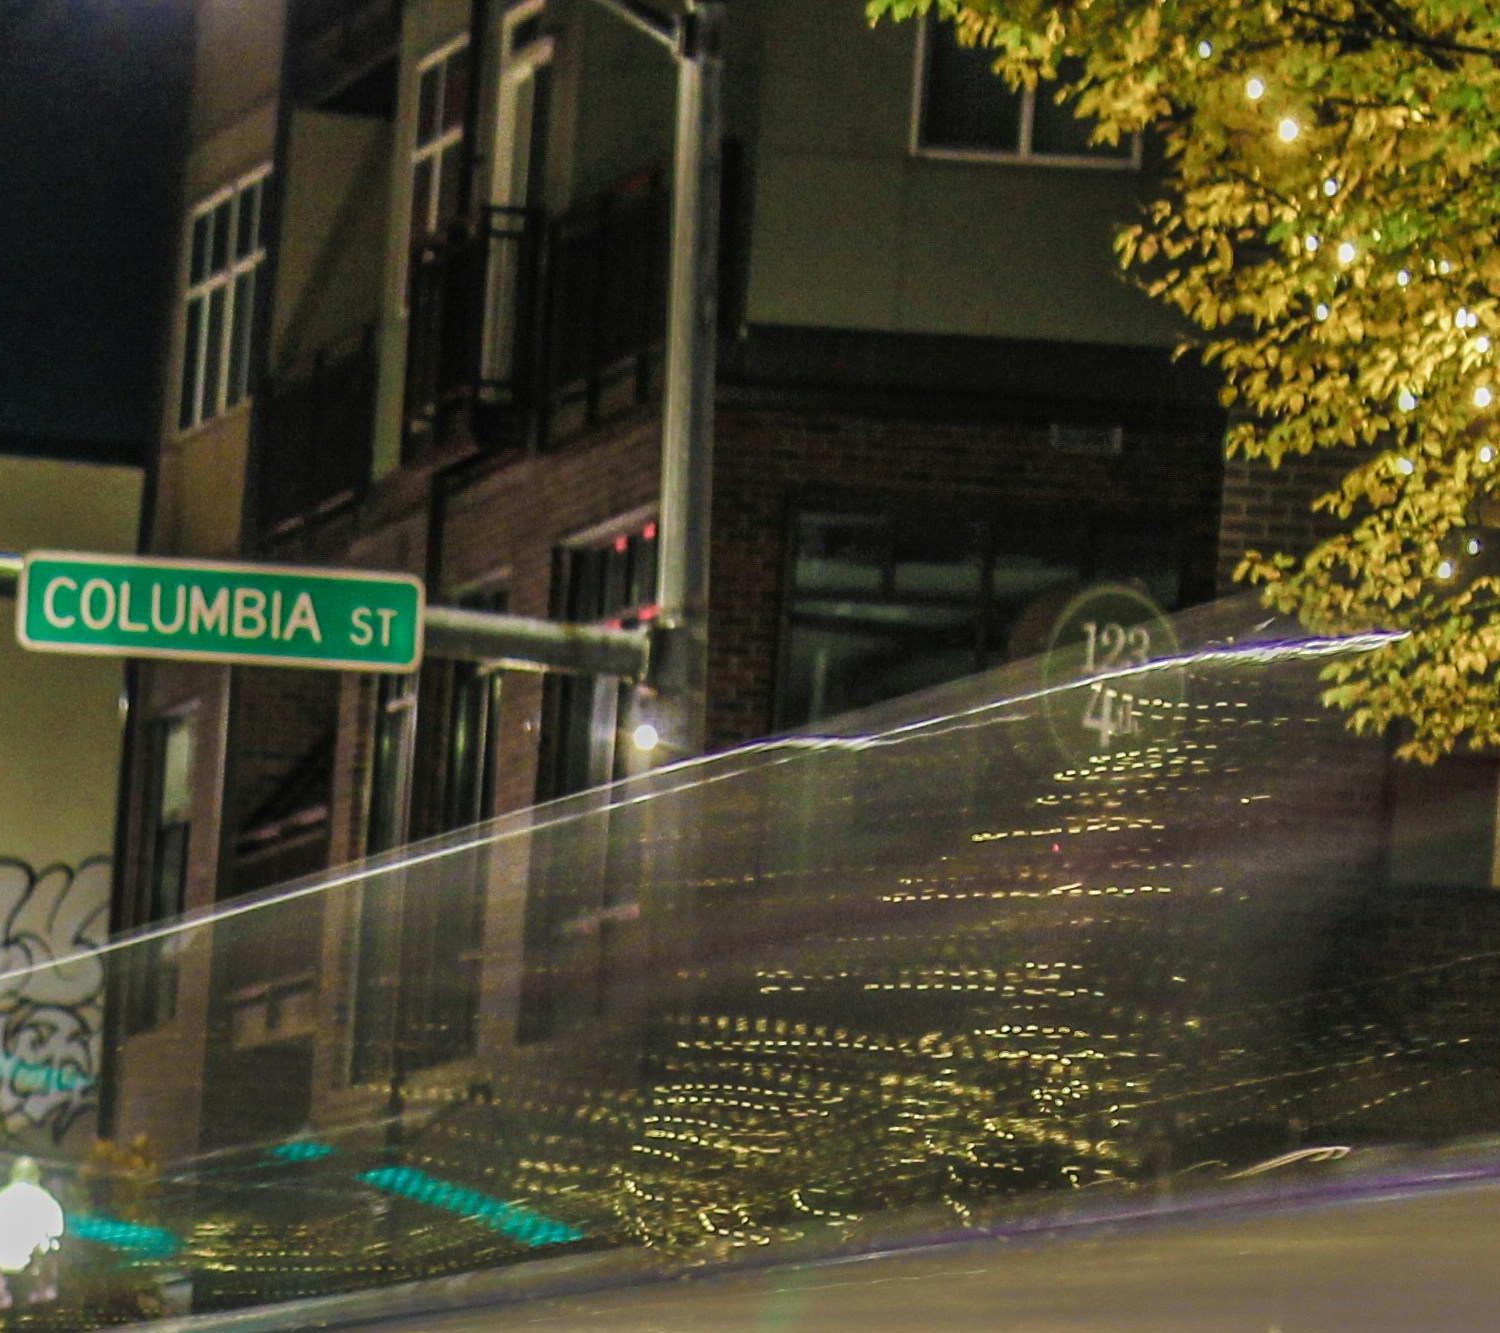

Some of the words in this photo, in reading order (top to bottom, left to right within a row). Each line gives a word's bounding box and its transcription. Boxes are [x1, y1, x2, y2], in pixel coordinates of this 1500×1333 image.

[43, 576, 322, 643] COLUMBIA
[349, 607, 398, 647] ST
[1082, 621, 1150, 680] 123
